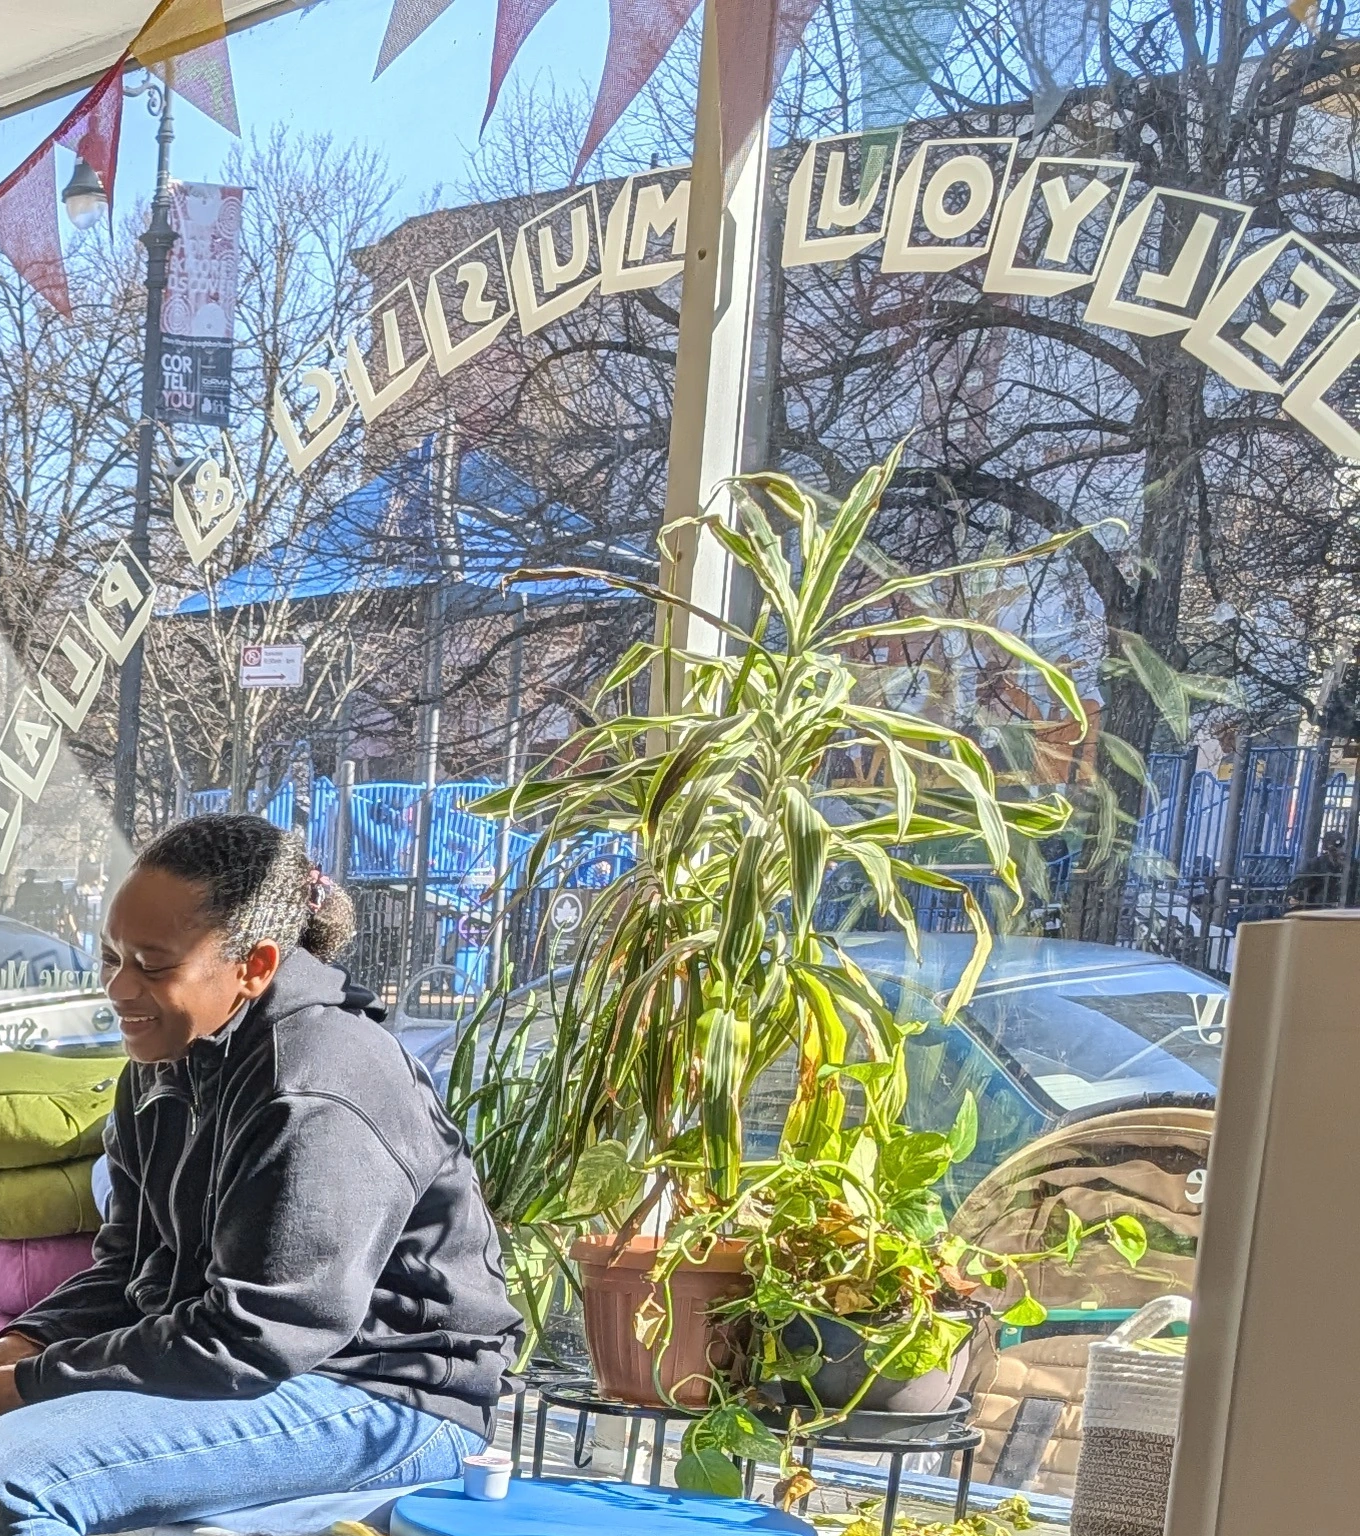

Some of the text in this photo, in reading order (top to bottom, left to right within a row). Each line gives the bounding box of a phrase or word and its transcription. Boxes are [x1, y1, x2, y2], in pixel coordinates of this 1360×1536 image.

[161, 353, 193, 374] COR
[162, 371, 187, 391] TEL
[162, 390, 195, 409] YOU
